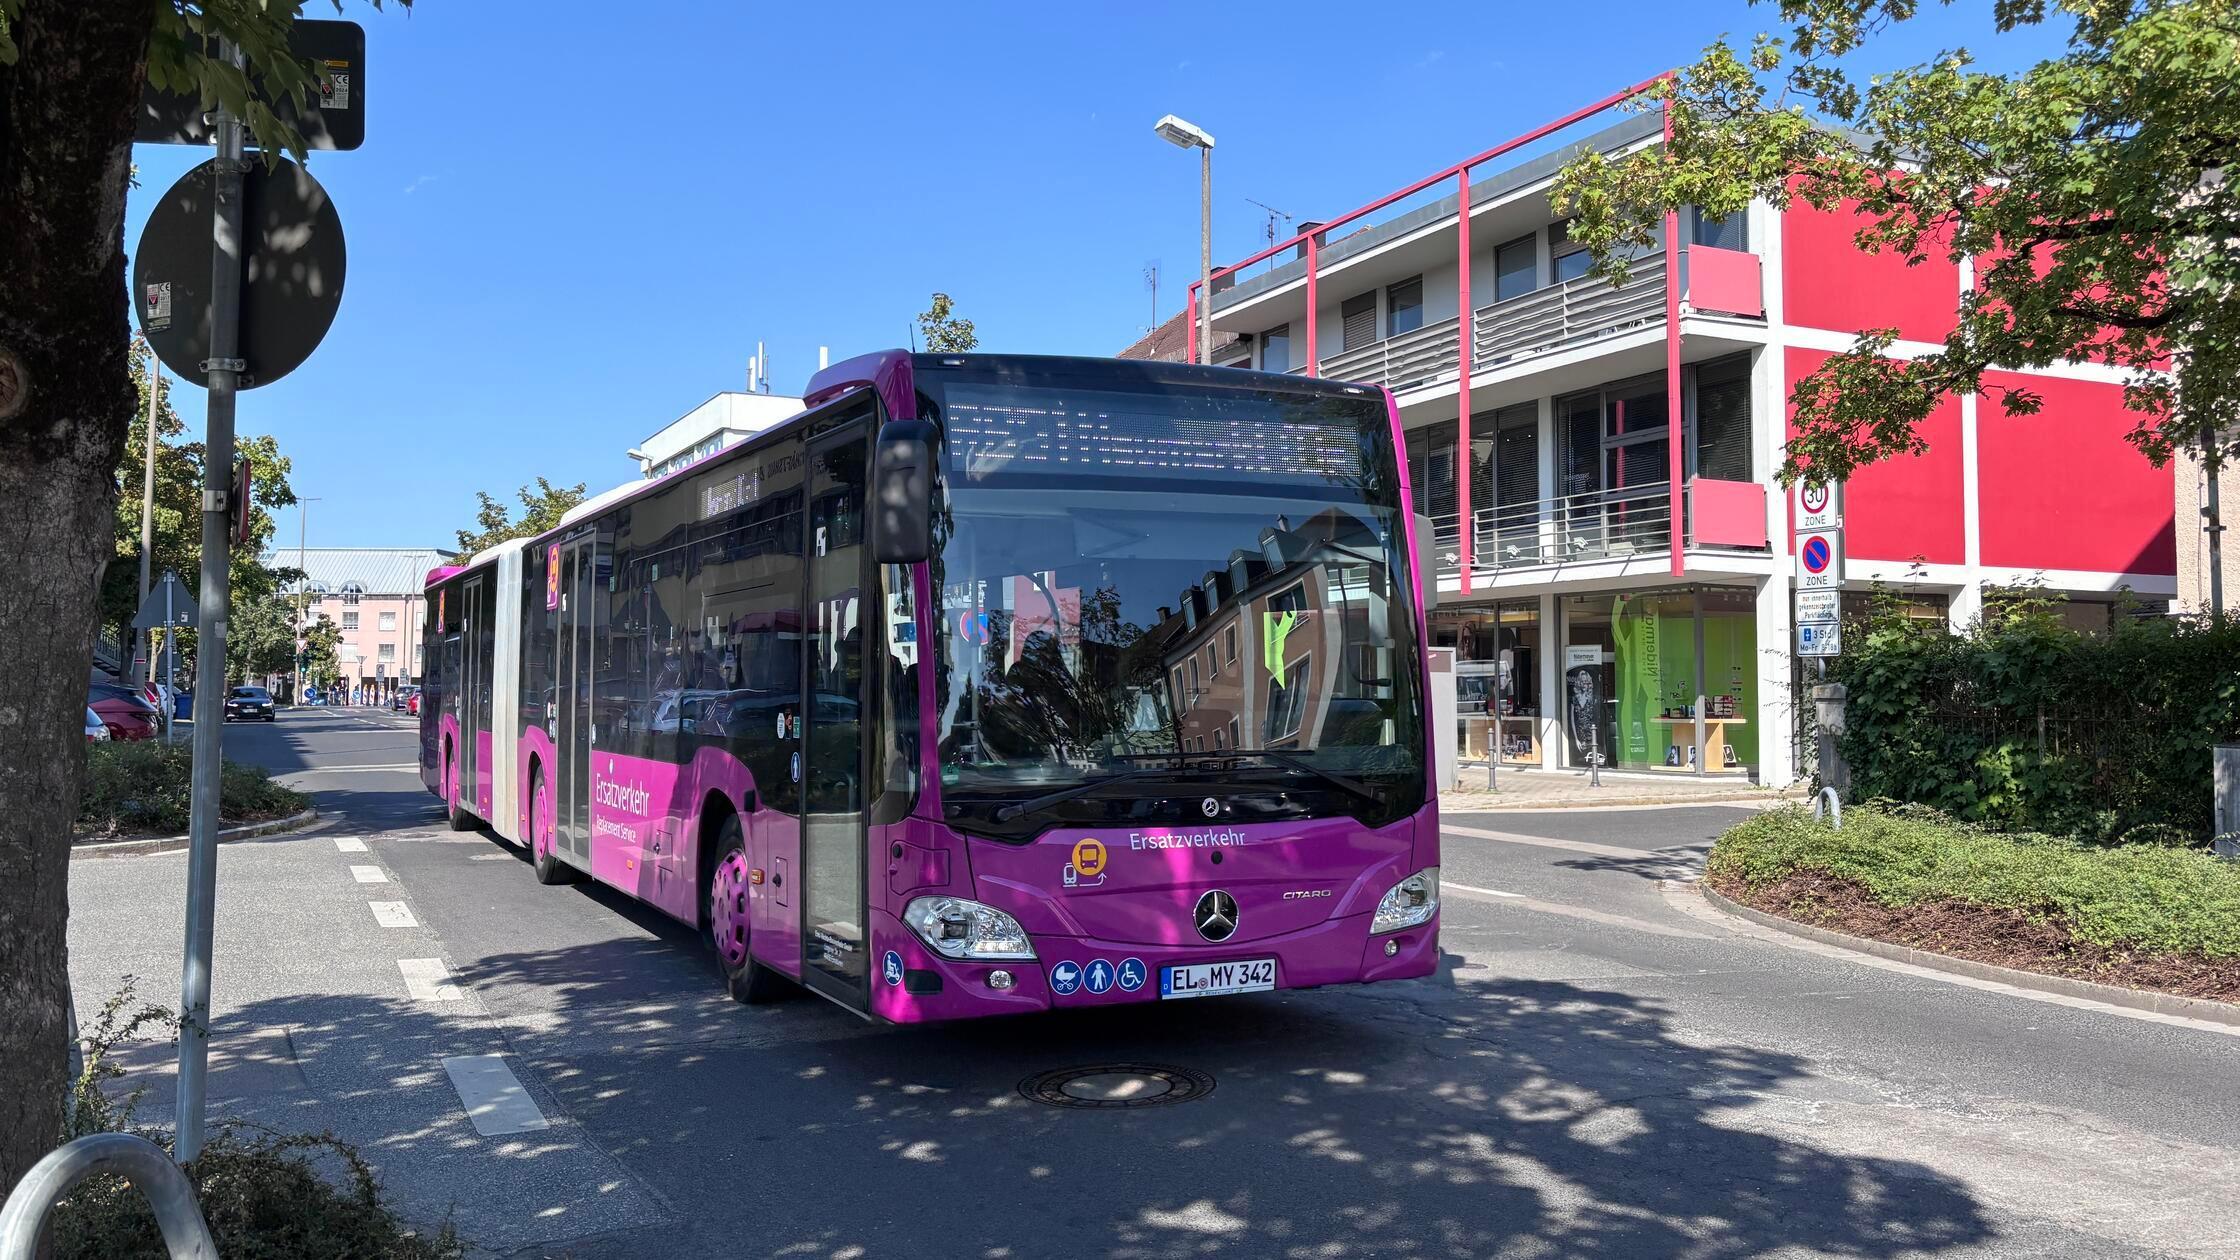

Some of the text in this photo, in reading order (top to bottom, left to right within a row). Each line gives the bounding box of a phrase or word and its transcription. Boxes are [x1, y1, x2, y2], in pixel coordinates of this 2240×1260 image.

[1805, 514, 1826, 526] ZONE
[1806, 575, 1828, 586] ZONE
[1813, 630, 1818, 639] 3
[1800, 643, 1819, 652] Mo-Fr
[596, 772, 650, 817] Ersatzverkehr
[596, 814, 637, 844] Replacement Service
[1129, 827, 1246, 851] Ersatzverkehr
[1282, 889, 1332, 900] CITARO
[1173, 962, 1272, 990] EL MY 342
